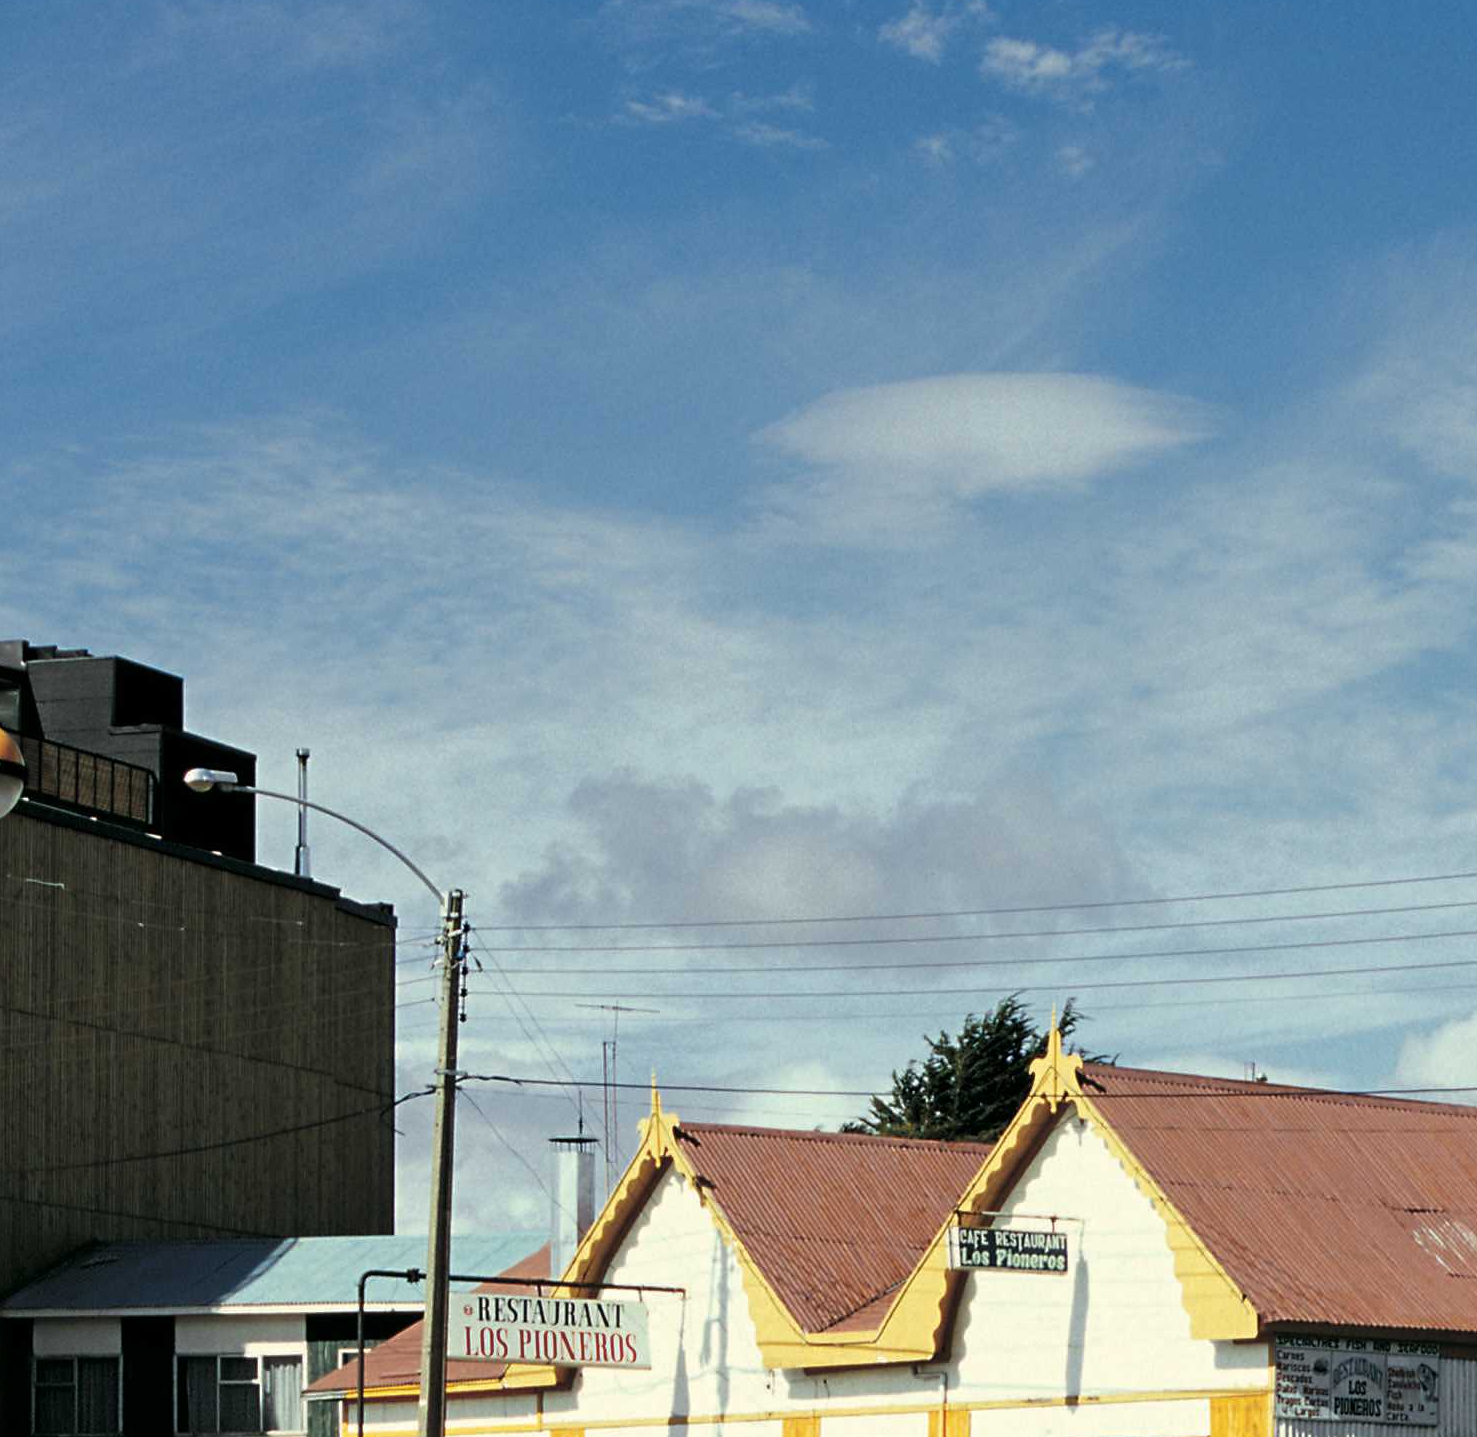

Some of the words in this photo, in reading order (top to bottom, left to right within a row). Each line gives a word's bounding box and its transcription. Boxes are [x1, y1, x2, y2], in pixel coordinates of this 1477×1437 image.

[959, 1229, 989, 1248] CAFE
[995, 1231, 1066, 1253] RESTAURANT
[961, 1247, 990, 1266] Los
[996, 1249, 1065, 1270] Pioneros
[477, 1296, 624, 1329] RESTAURANT
[464, 1326, 508, 1359] LOS
[518, 1329, 637, 1364] PIONEROS
[1348, 1380, 1367, 1395] LOS
[1334, 1397, 1382, 1417] PIONEROS
